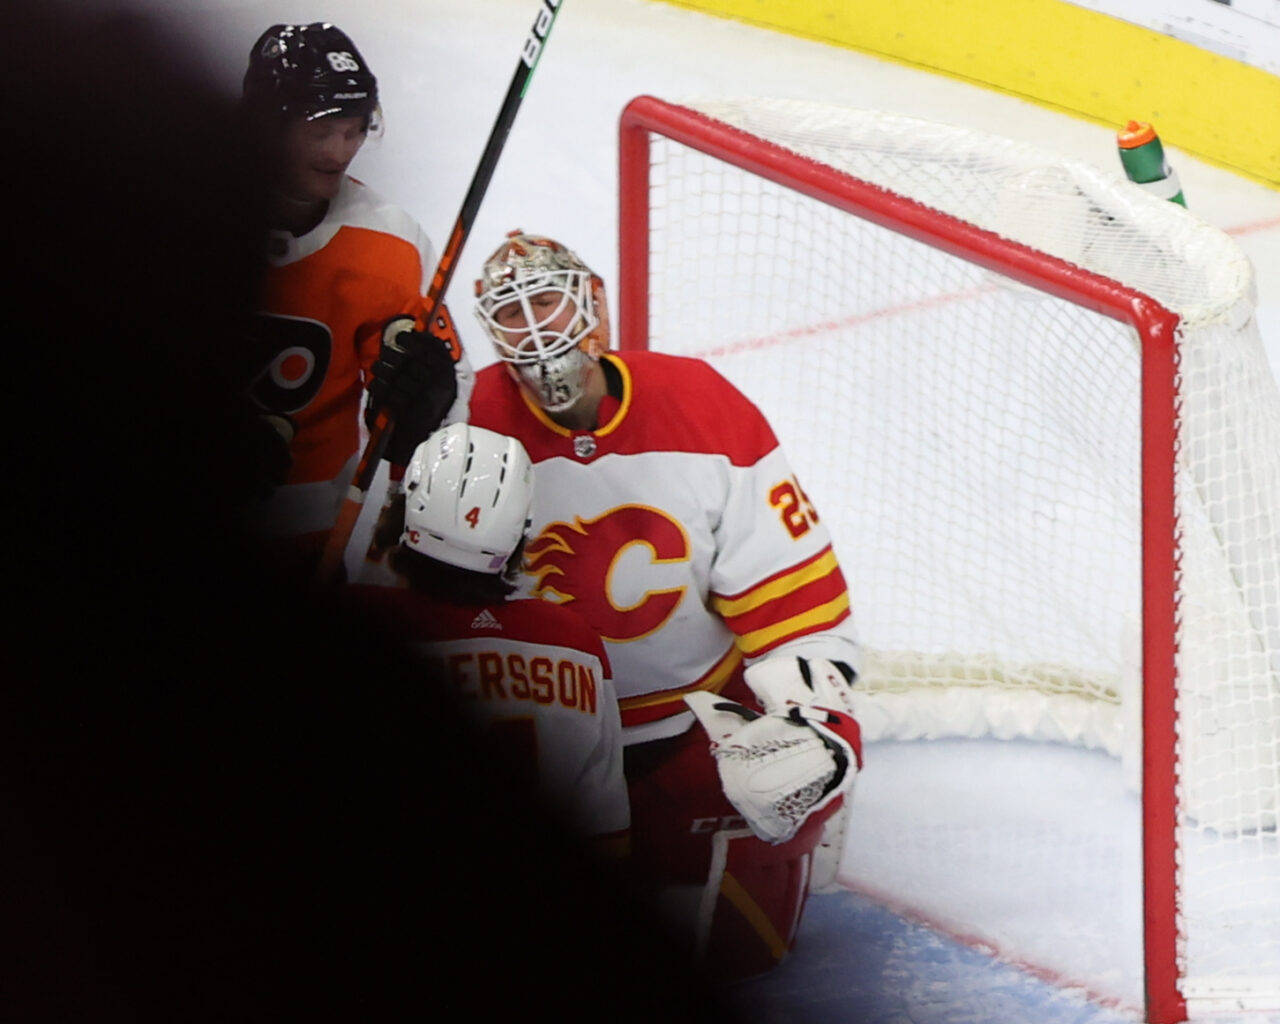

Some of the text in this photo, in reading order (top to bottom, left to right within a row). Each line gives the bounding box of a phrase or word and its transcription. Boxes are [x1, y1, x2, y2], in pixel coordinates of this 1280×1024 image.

[326, 51, 360, 72] 86
[465, 506, 481, 529] 4
[450, 651, 598, 715] ERSSON
